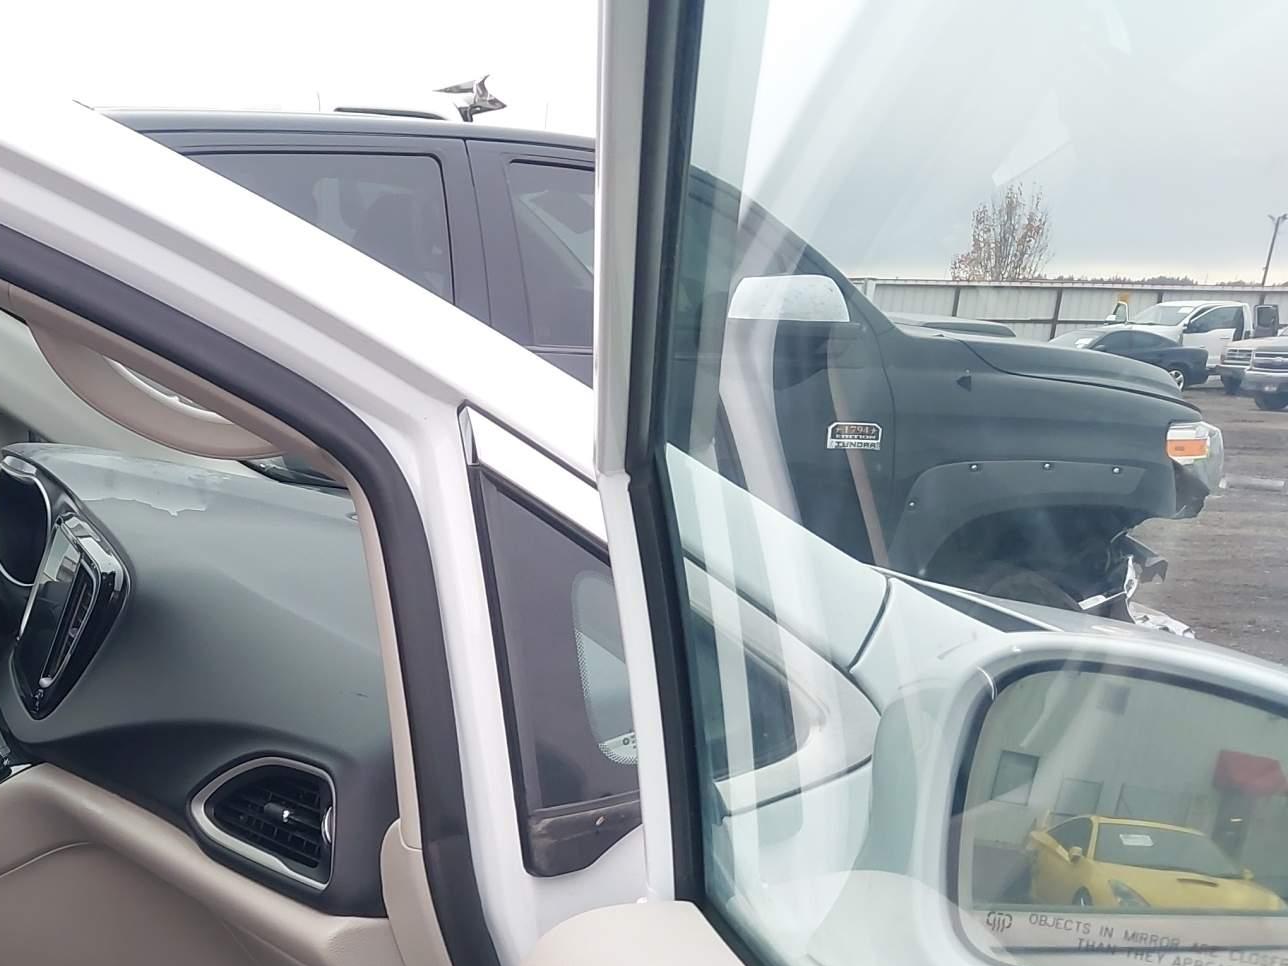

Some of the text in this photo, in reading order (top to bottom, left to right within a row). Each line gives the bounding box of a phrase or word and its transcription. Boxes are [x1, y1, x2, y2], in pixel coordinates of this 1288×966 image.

[845, 425, 870, 433] 1794
[835, 441, 876, 449] TUNDRA
[1028, 913, 1091, 935] OBJECTS
[1099, 925, 1114, 939] IN
[1123, 929, 1180, 949] MIRROR
[1192, 942, 1220, 959] ARE
[1078, 937, 1116, 955] THAN
[1126, 947, 1166, 965] THEY
